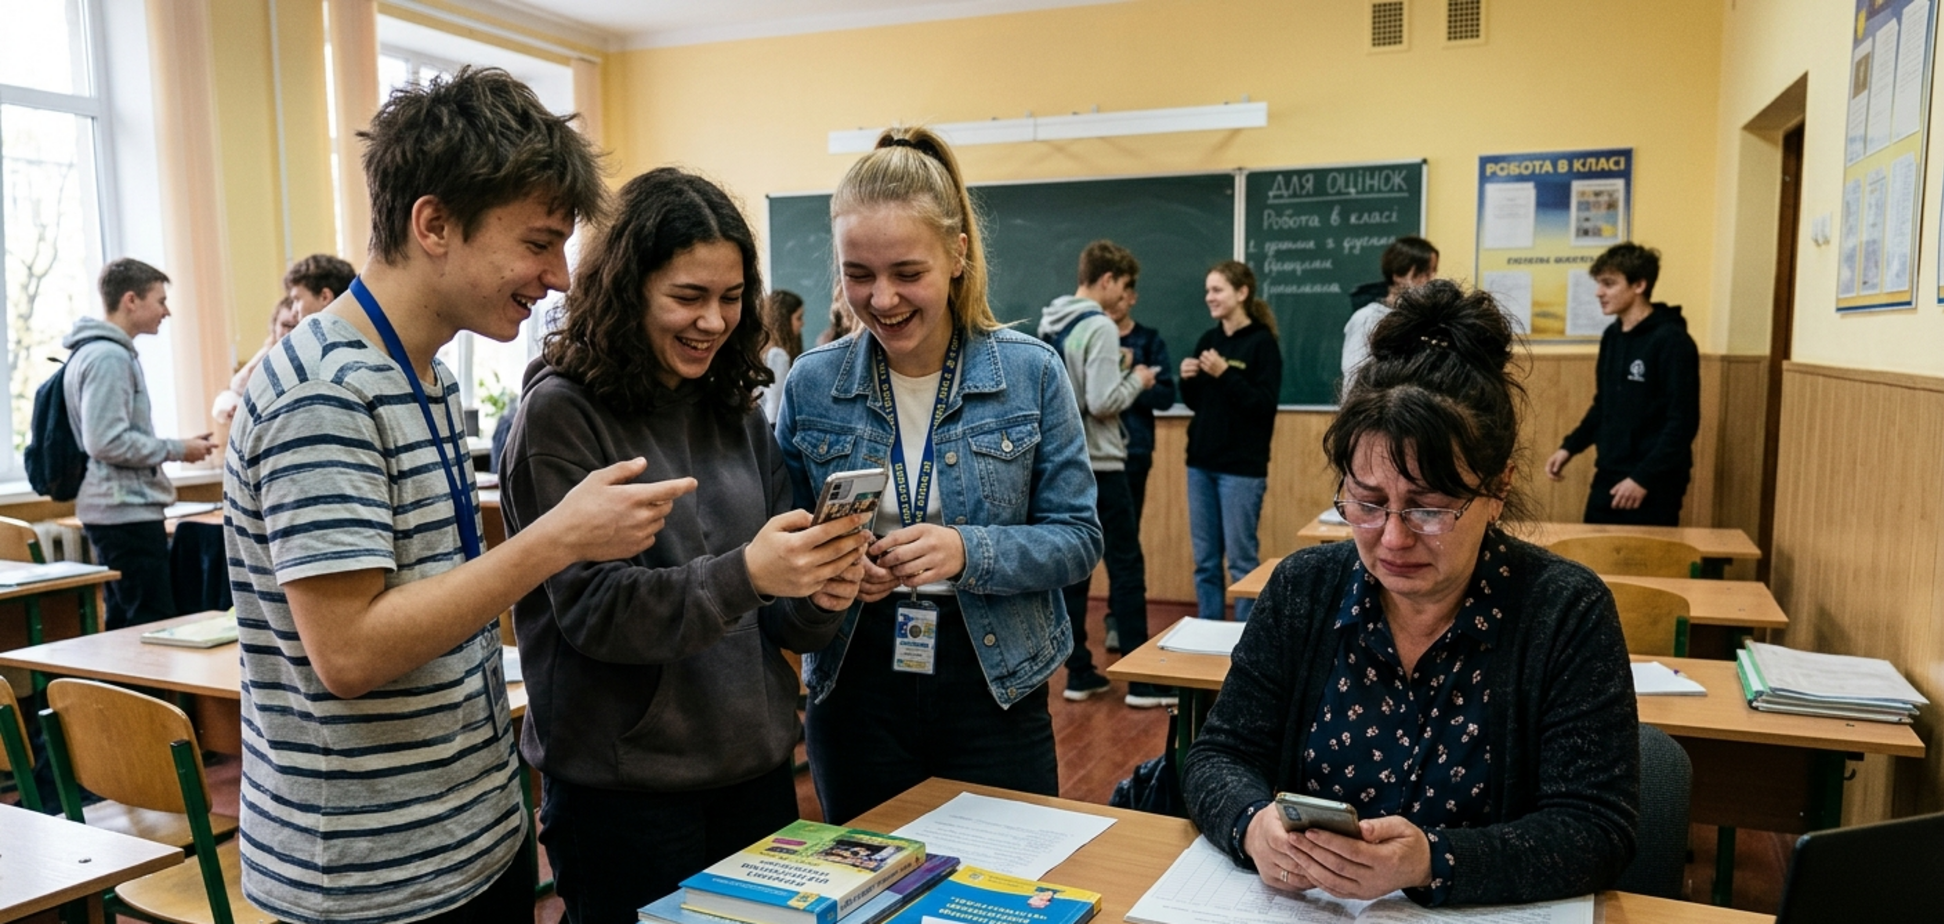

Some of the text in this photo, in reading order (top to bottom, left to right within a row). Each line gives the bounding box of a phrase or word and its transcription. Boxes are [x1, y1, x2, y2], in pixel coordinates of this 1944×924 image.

[1485, 156, 1626, 177] РОБОТА В КЛАСІ
[1268, 173, 1314, 198] ДЛЯ
[1262, 204, 1399, 230] Робота в класі
